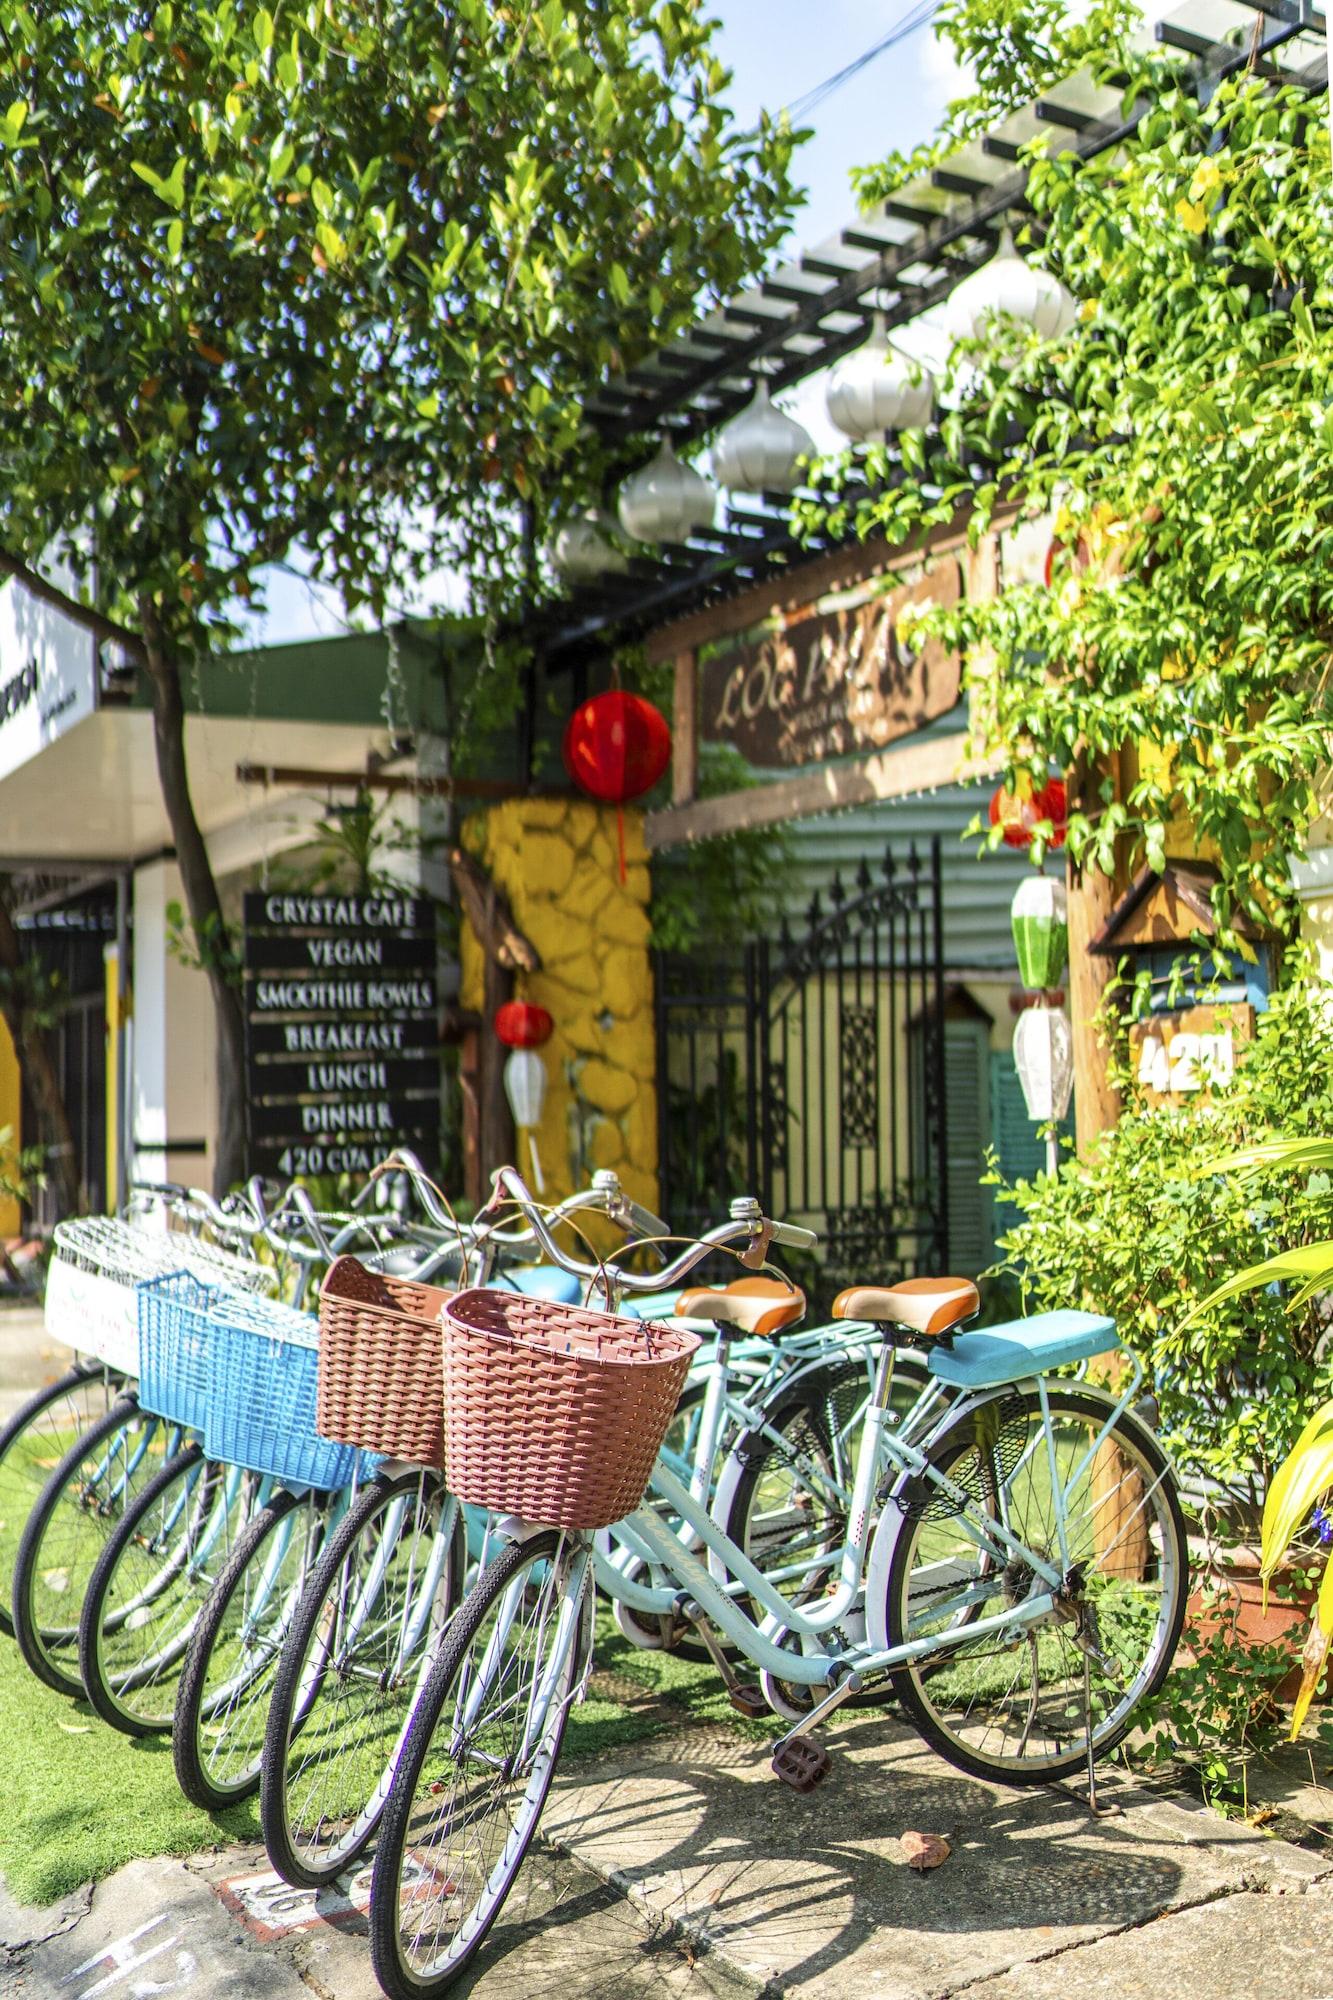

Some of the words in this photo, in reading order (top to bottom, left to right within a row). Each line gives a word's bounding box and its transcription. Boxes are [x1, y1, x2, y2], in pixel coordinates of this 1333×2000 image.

[266, 896, 361, 925] CRYSTAL
[363, 899, 416, 927] CAFE
[307, 938, 382, 967] VEGAN
[256, 981, 363, 1009] SMOOTHIE
[367, 980, 432, 1009] BOWLS
[285, 1023, 403, 1051] BREAKFAST
[1138, 1030, 1233, 1092] 420
[307, 1063, 386, 1090] LUNCH
[302, 1102, 393, 1133] DINNER
[278, 1145, 323, 1176] 420
